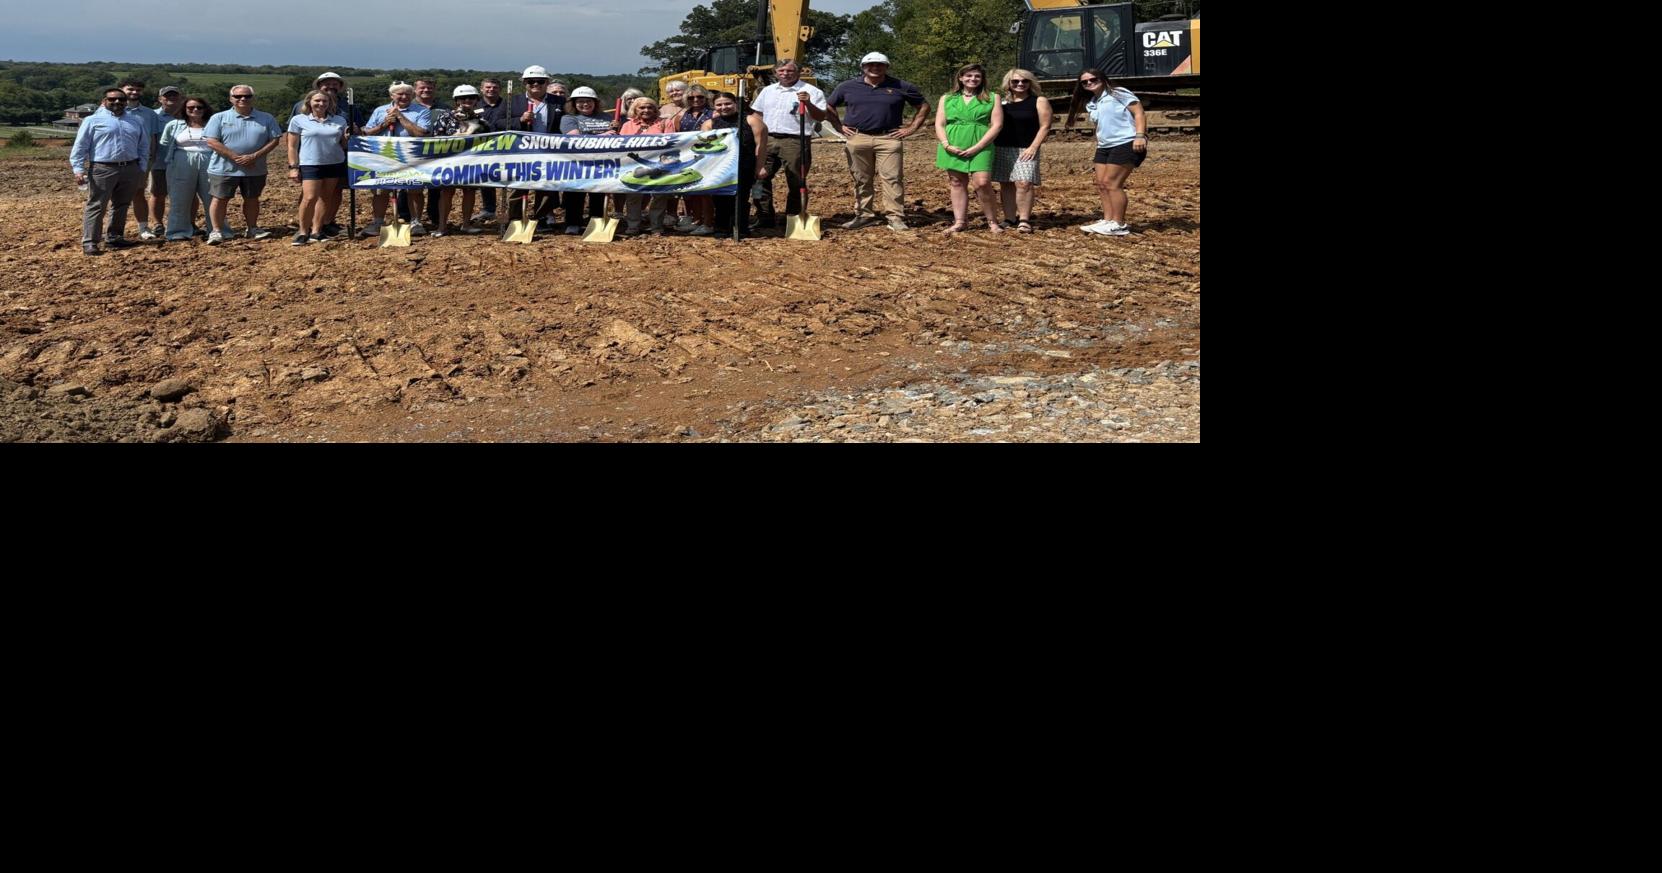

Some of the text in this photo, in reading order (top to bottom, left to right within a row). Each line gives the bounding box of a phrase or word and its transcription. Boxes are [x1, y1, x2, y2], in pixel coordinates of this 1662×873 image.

[1143, 31, 1183, 48] CAT
[1144, 49, 1168, 57] 336E
[422, 134, 672, 155] TWO NEW SNOW TUBING HILLS
[431, 164, 502, 186] COMING
[504, 160, 542, 182] THIS
[544, 158, 621, 181] WINTER!
